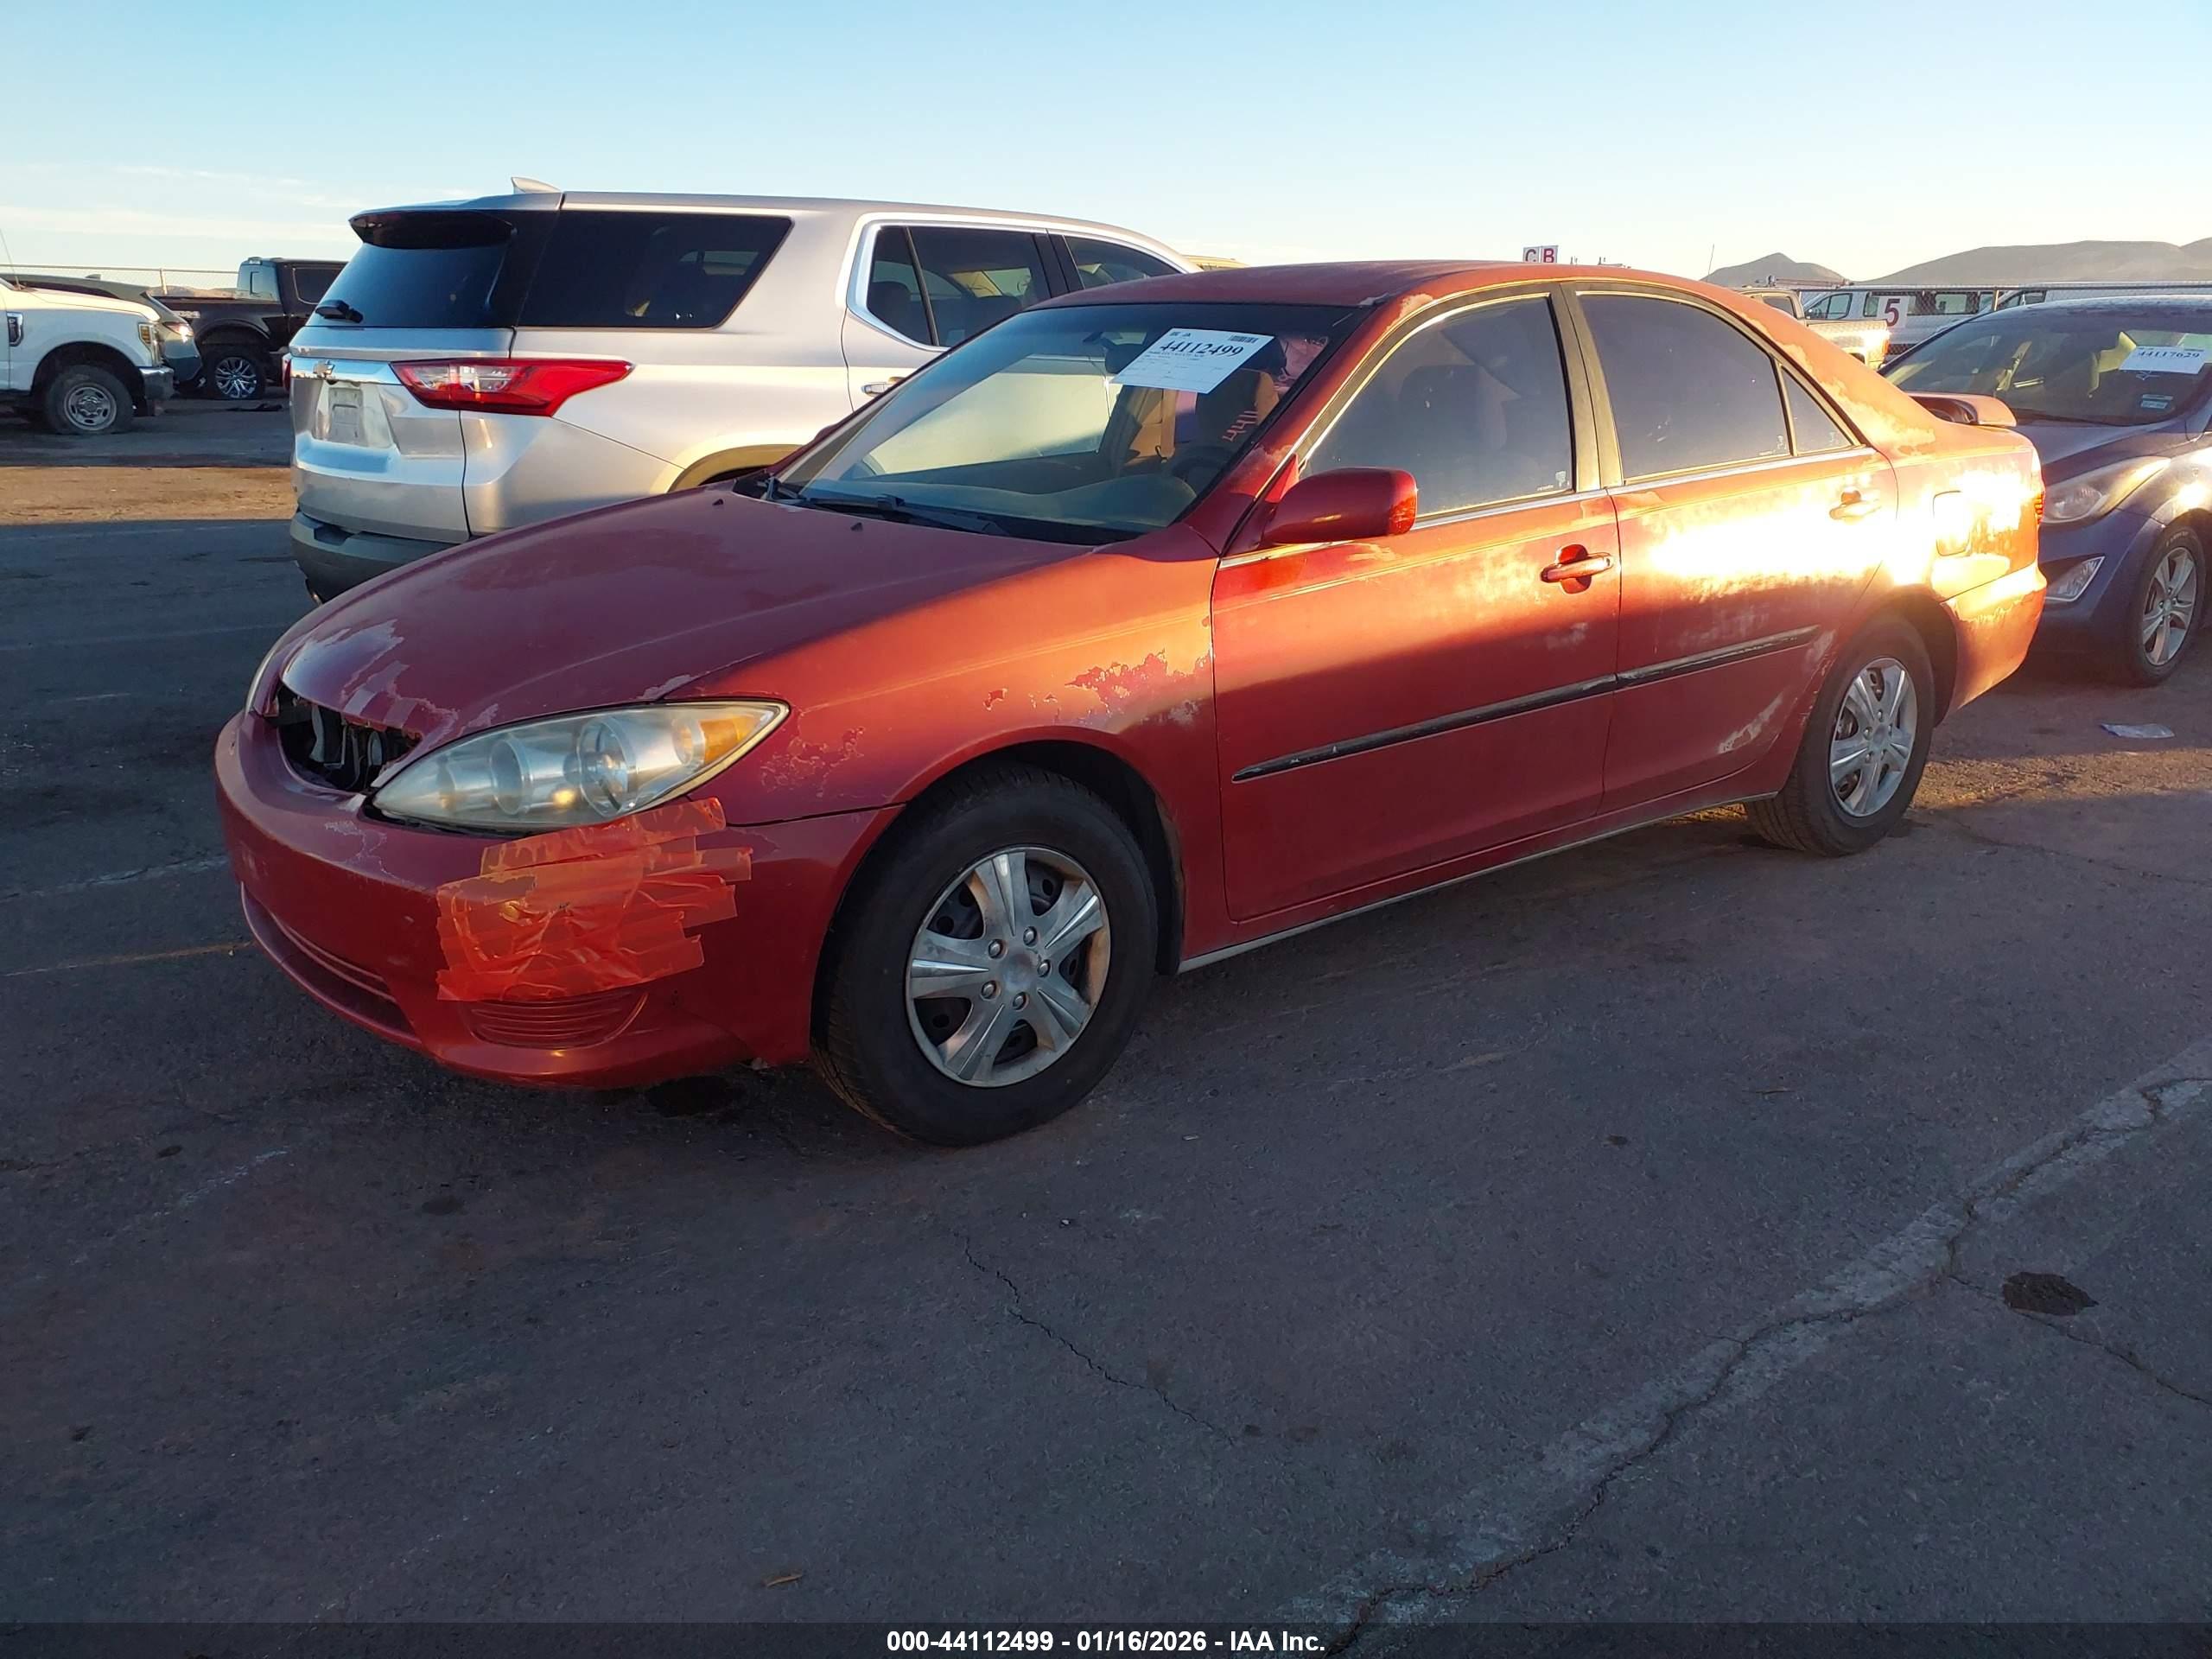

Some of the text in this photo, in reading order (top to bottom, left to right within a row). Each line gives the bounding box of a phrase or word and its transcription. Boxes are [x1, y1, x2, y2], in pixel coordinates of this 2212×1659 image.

[1542, 247, 1554, 263] B
[1884, 298, 1901, 327] 5
[1160, 340, 1244, 357] 44112499
